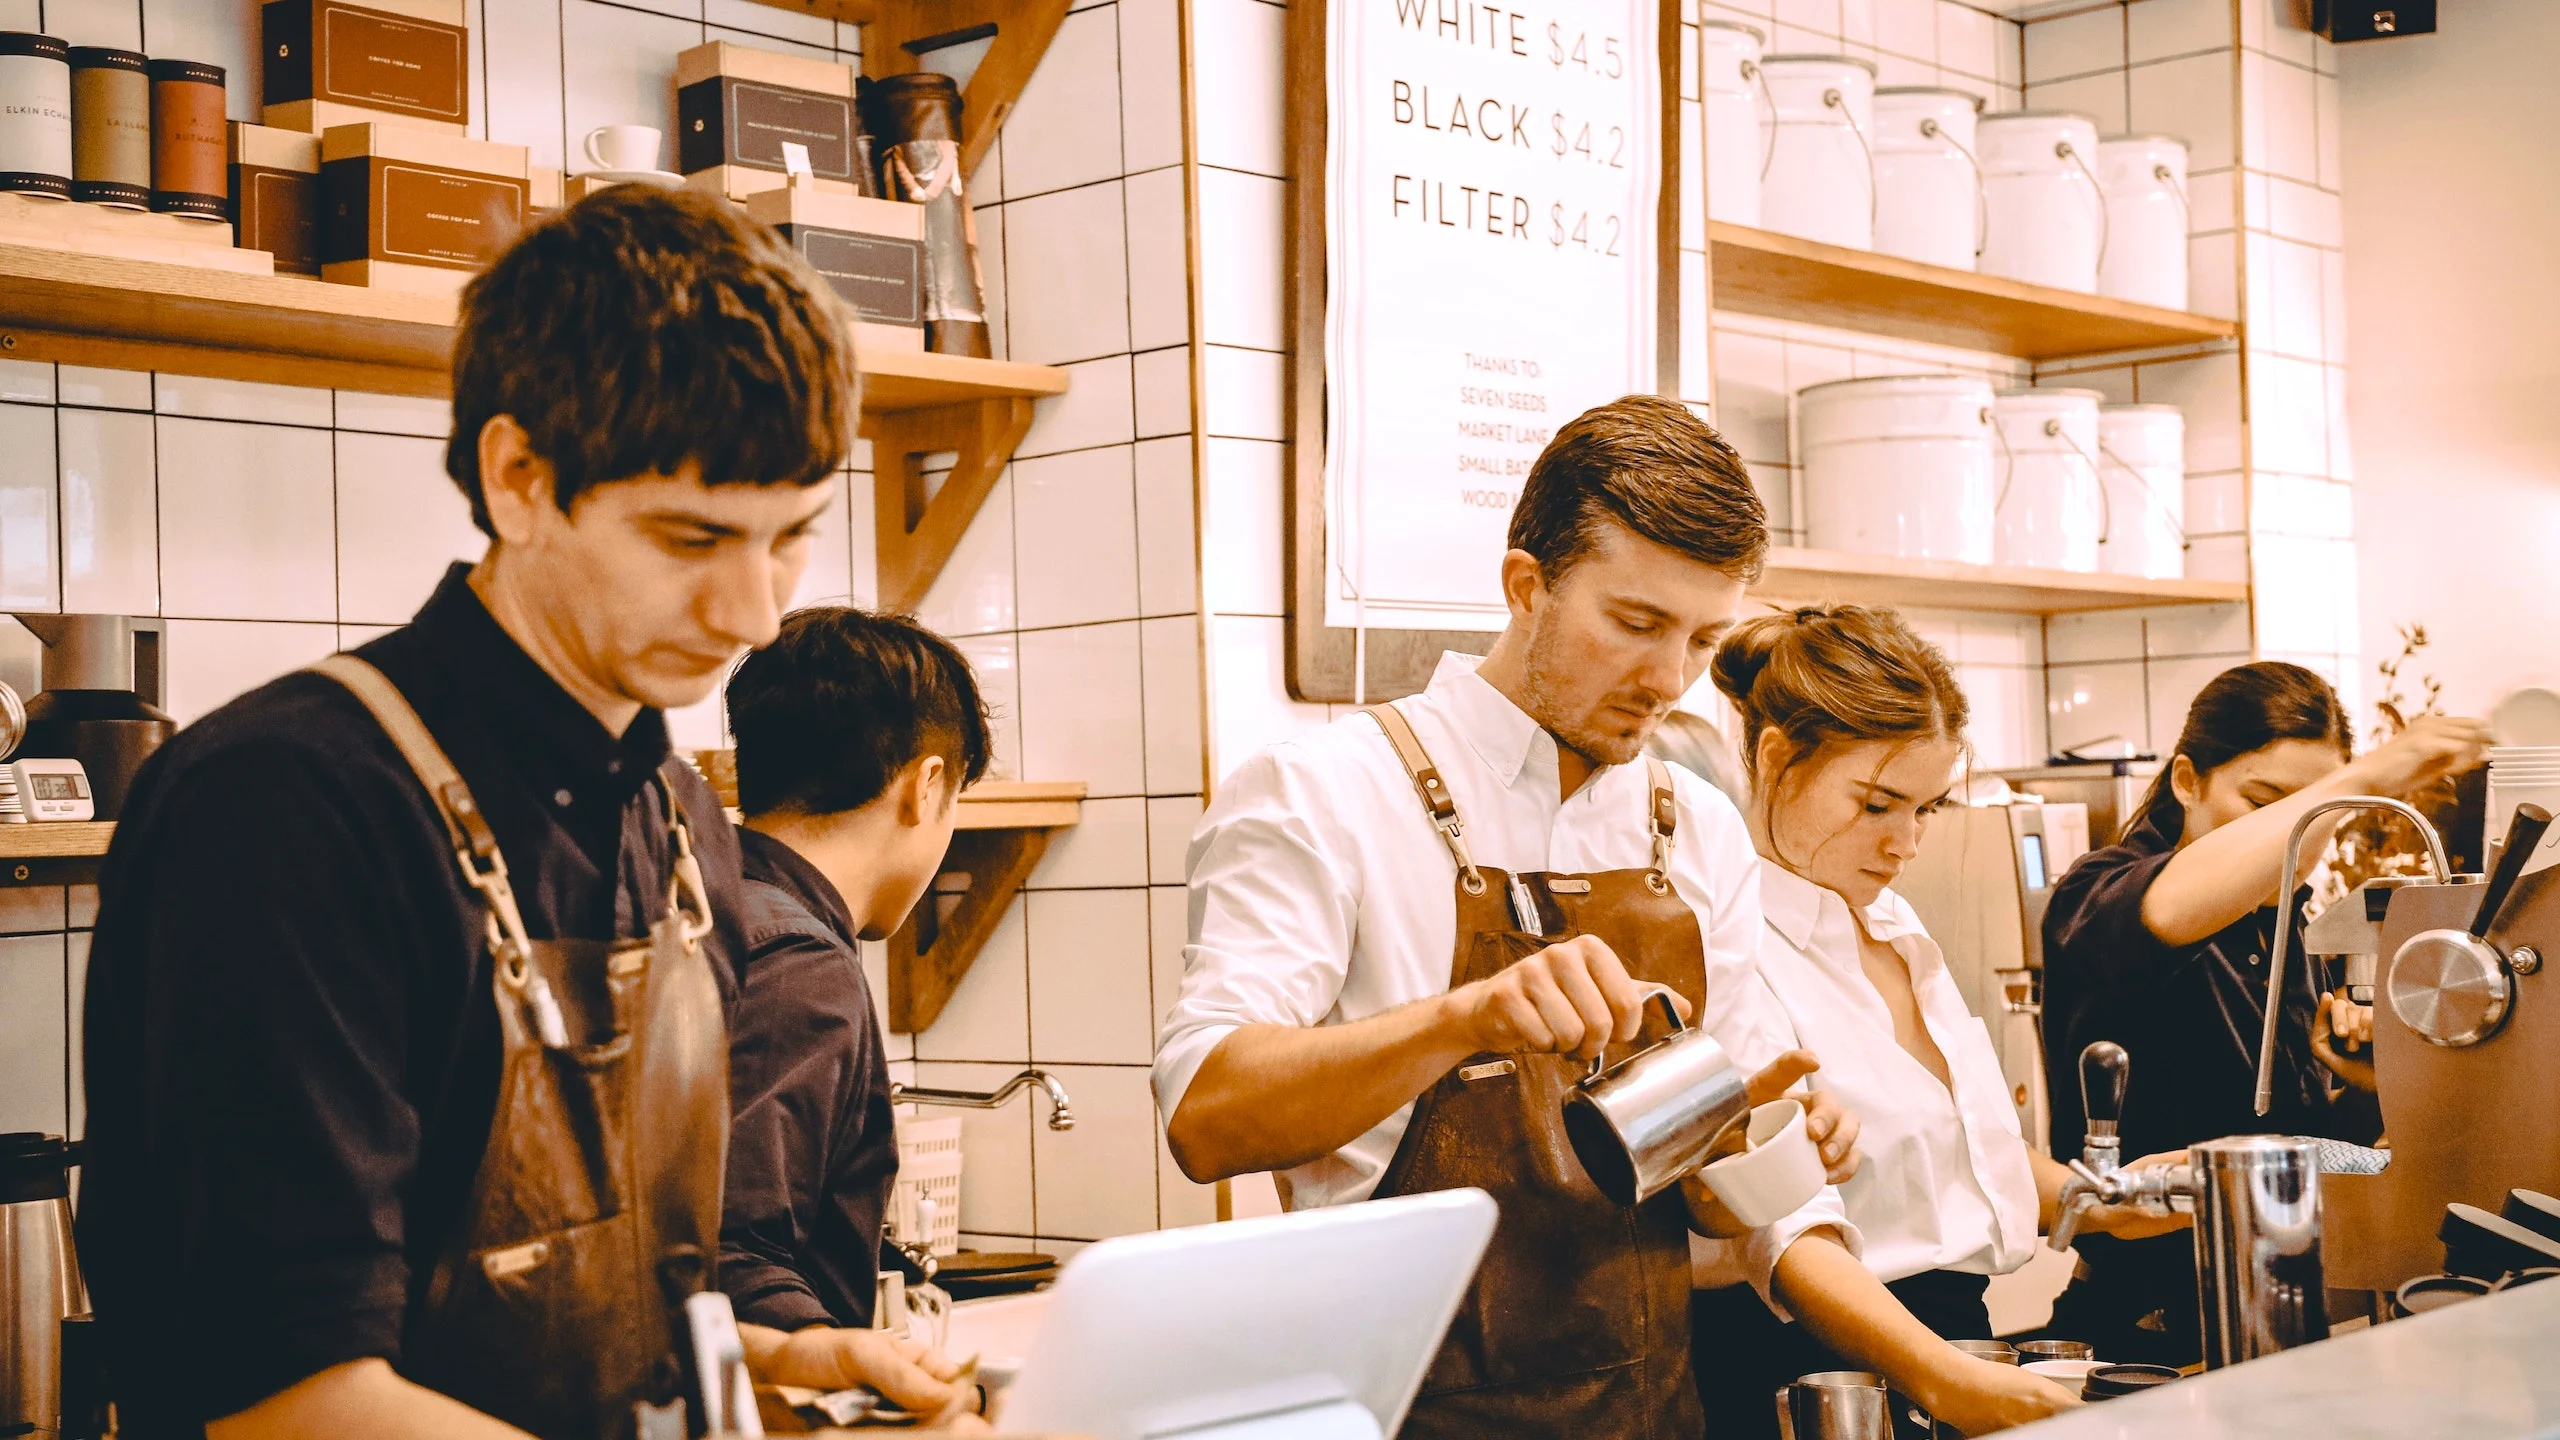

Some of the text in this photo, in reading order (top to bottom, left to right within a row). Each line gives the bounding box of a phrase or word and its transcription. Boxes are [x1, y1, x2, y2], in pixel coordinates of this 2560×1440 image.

[1396, 0, 1623, 80] WHITE $4.5
[6, 105, 40, 115] ELKIN
[1394, 79, 1624, 169] BLACK $4.2
[1394, 174, 1621, 257] FILTER $4.2
[1464, 352, 1518, 376] THANKS
[1461, 386, 1547, 413] SEVEN SEEDS
[1458, 420, 1550, 446] MARKET LANE
[1458, 454, 1502, 475] SMALL
[1461, 490, 1508, 509] WOOD
